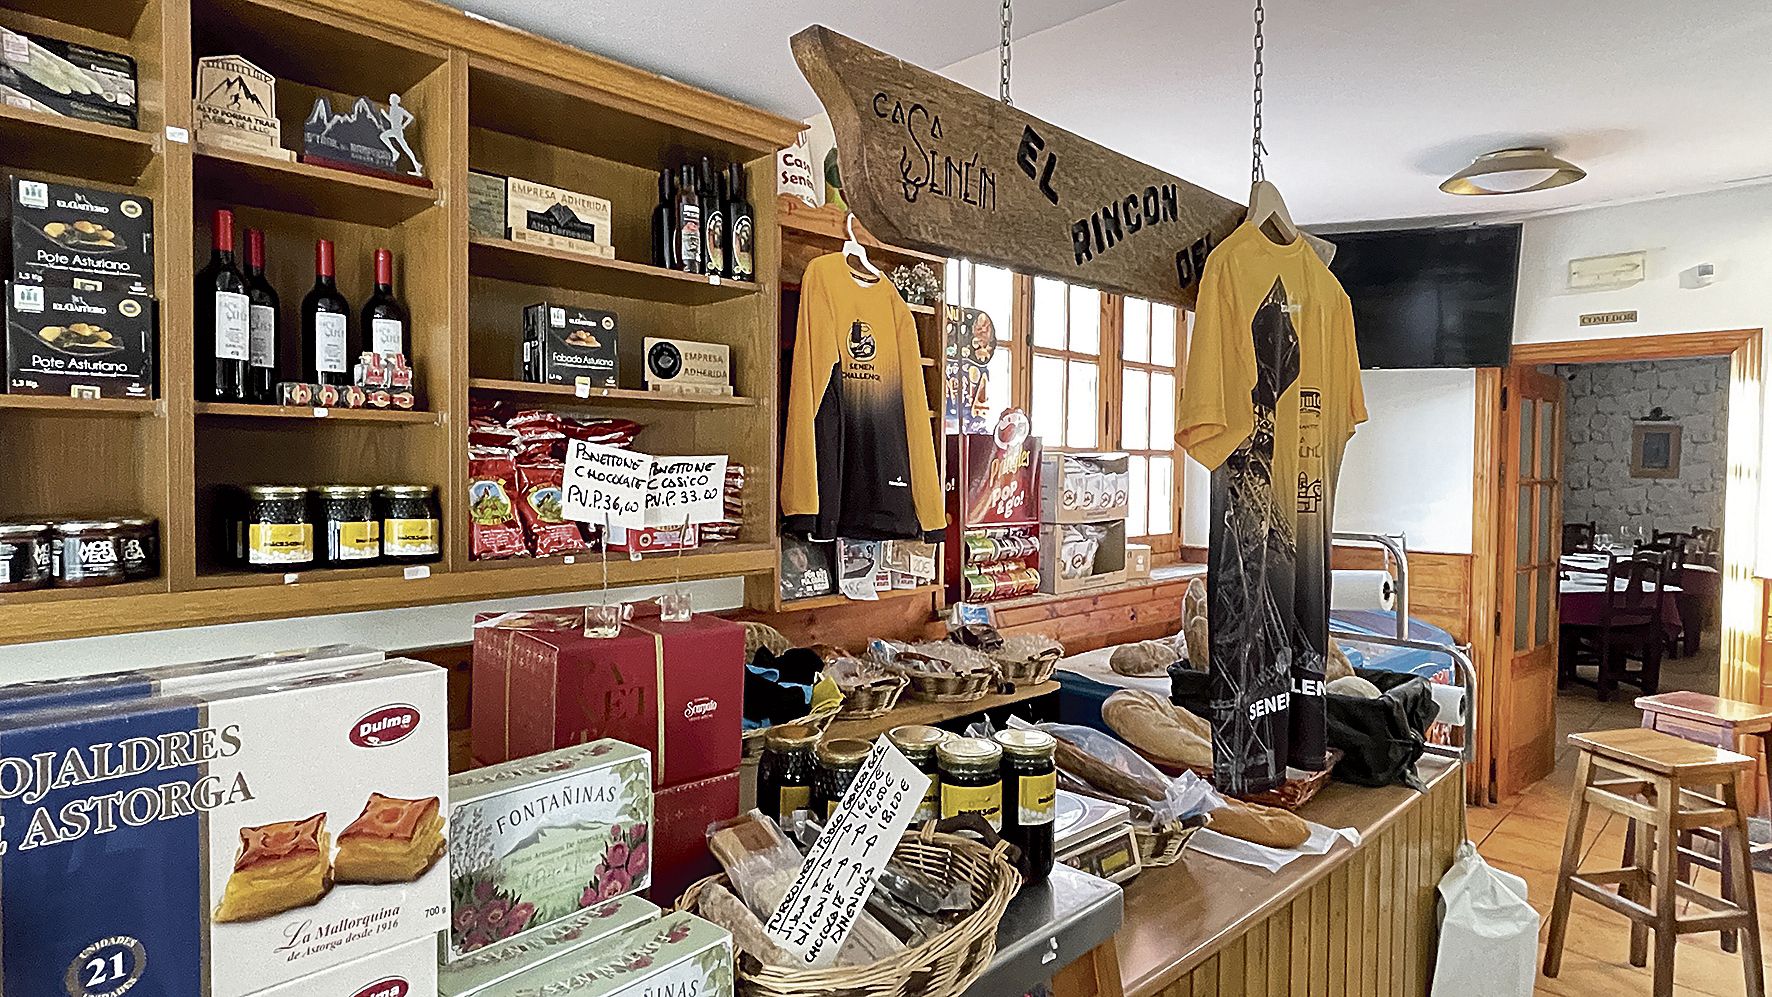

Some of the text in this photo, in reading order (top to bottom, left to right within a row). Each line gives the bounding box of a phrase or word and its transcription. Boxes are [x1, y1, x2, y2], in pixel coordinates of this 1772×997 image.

[1016, 124, 1059, 205] EL
[511, 182, 556, 200] EMPRESA
[561, 194, 608, 212] ADHERIDA
[1071, 183, 1179, 266] RINCON
[37, 250, 131, 271] Pote Asturiano
[1581, 312, 1635, 325] COMEDOR
[32, 355, 128, 372] Pote Asturiano
[552, 352, 582, 364] Fabada
[684, 352, 724, 364] EMPRESA
[683, 368, 728, 379] ADHERIDA
[359, 712, 412, 738] Dulma
[18, 771, 255, 851] ASTORGA
[496, 785, 617, 835] FONTAÑINAS
[424, 905, 441, 919] 700
[273, 905, 401, 954] La Mallorquina
[286, 920, 400, 963] de Astorga desde 1916
[85, 951, 127, 988] 21
